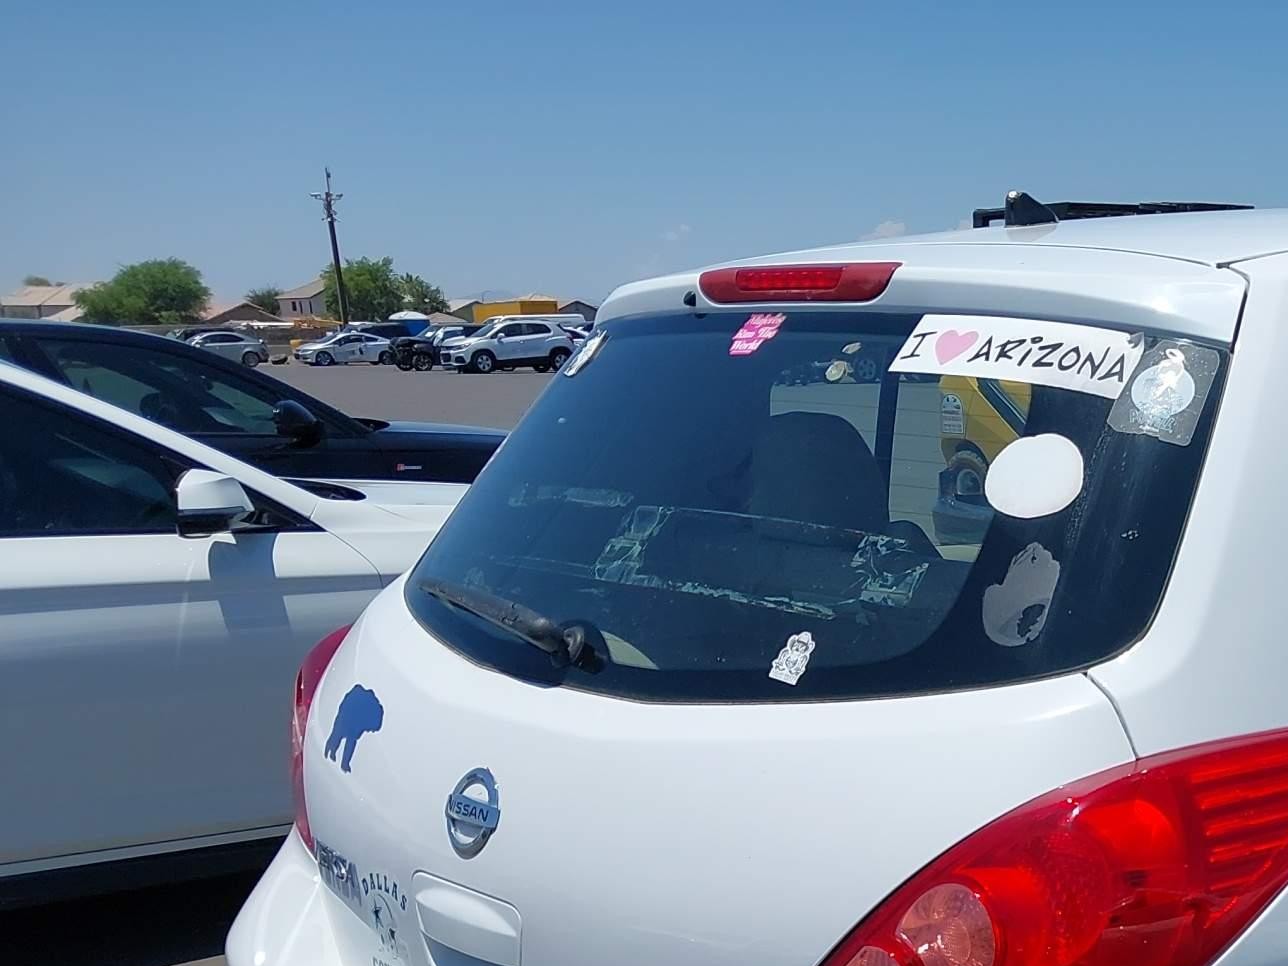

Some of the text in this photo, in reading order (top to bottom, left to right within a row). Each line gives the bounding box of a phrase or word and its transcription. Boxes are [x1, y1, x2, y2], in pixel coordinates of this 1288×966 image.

[900, 332, 937, 360] I
[448, 794, 489, 822] NISSAN
[361, 873, 407, 911] DALLAS
